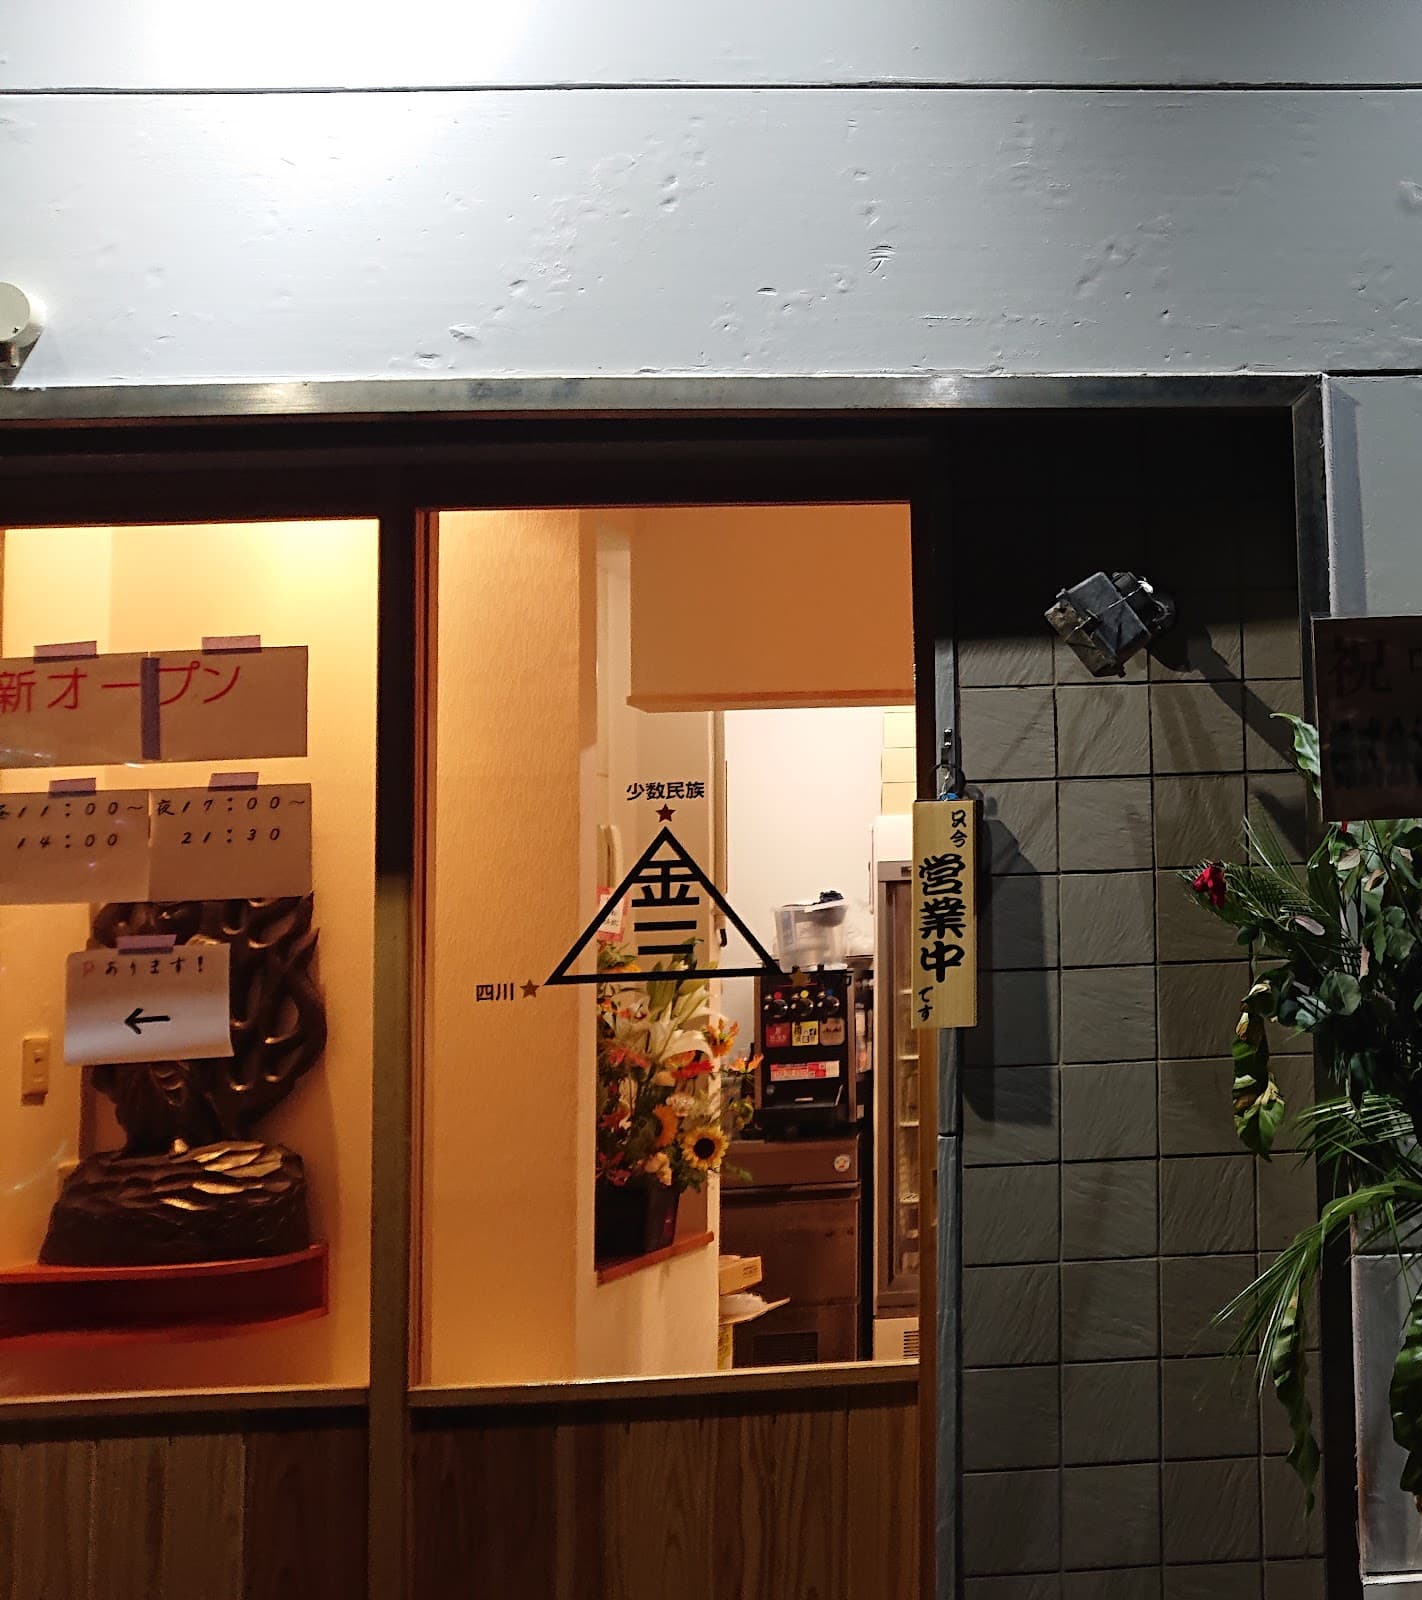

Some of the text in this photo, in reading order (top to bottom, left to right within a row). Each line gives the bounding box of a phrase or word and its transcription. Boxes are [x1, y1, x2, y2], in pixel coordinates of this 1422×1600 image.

[0, 659, 241, 714] 新オープン
[626, 780, 706, 802] 少数民族
[180, 827, 282, 845] 21:30
[918, 852, 967, 983] 営業中
[475, 982, 515, 1003] 四川
[917, 985, 934, 1022] です
